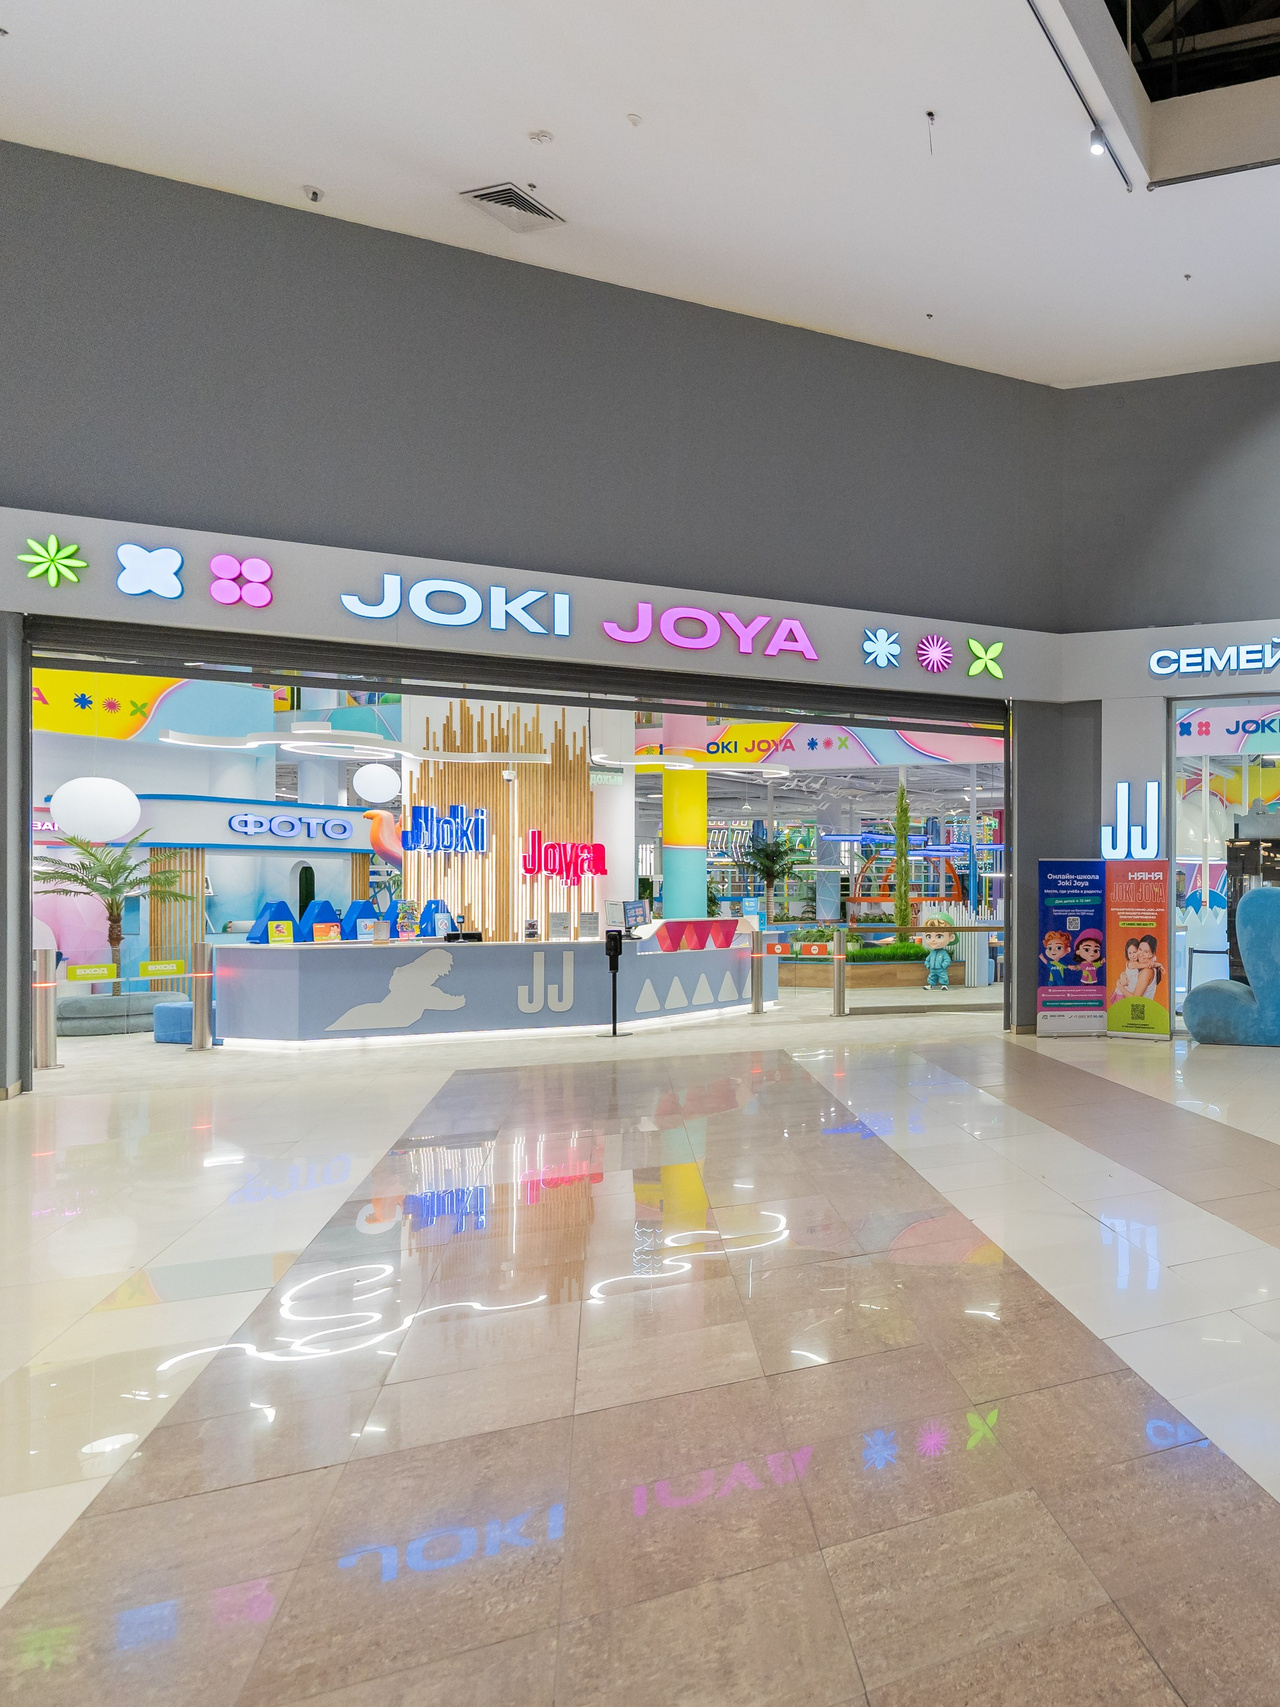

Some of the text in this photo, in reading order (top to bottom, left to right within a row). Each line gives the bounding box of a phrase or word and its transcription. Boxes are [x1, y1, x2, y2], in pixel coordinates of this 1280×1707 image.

[340, 572, 819, 661] JOKI JOYA
[706, 739, 796, 755] OKI JOYA
[228, 813, 354, 840] ФОТО
[1100, 781, 1160, 859] JJ
[1128, 872, 1163, 880] НЯНЯ
[1110, 882, 1166, 903] JOKI JOYA
[76, 967, 108, 975] ВХОД
[148, 963, 177, 971] ВХОД
[517, 950, 574, 1014] JJ
